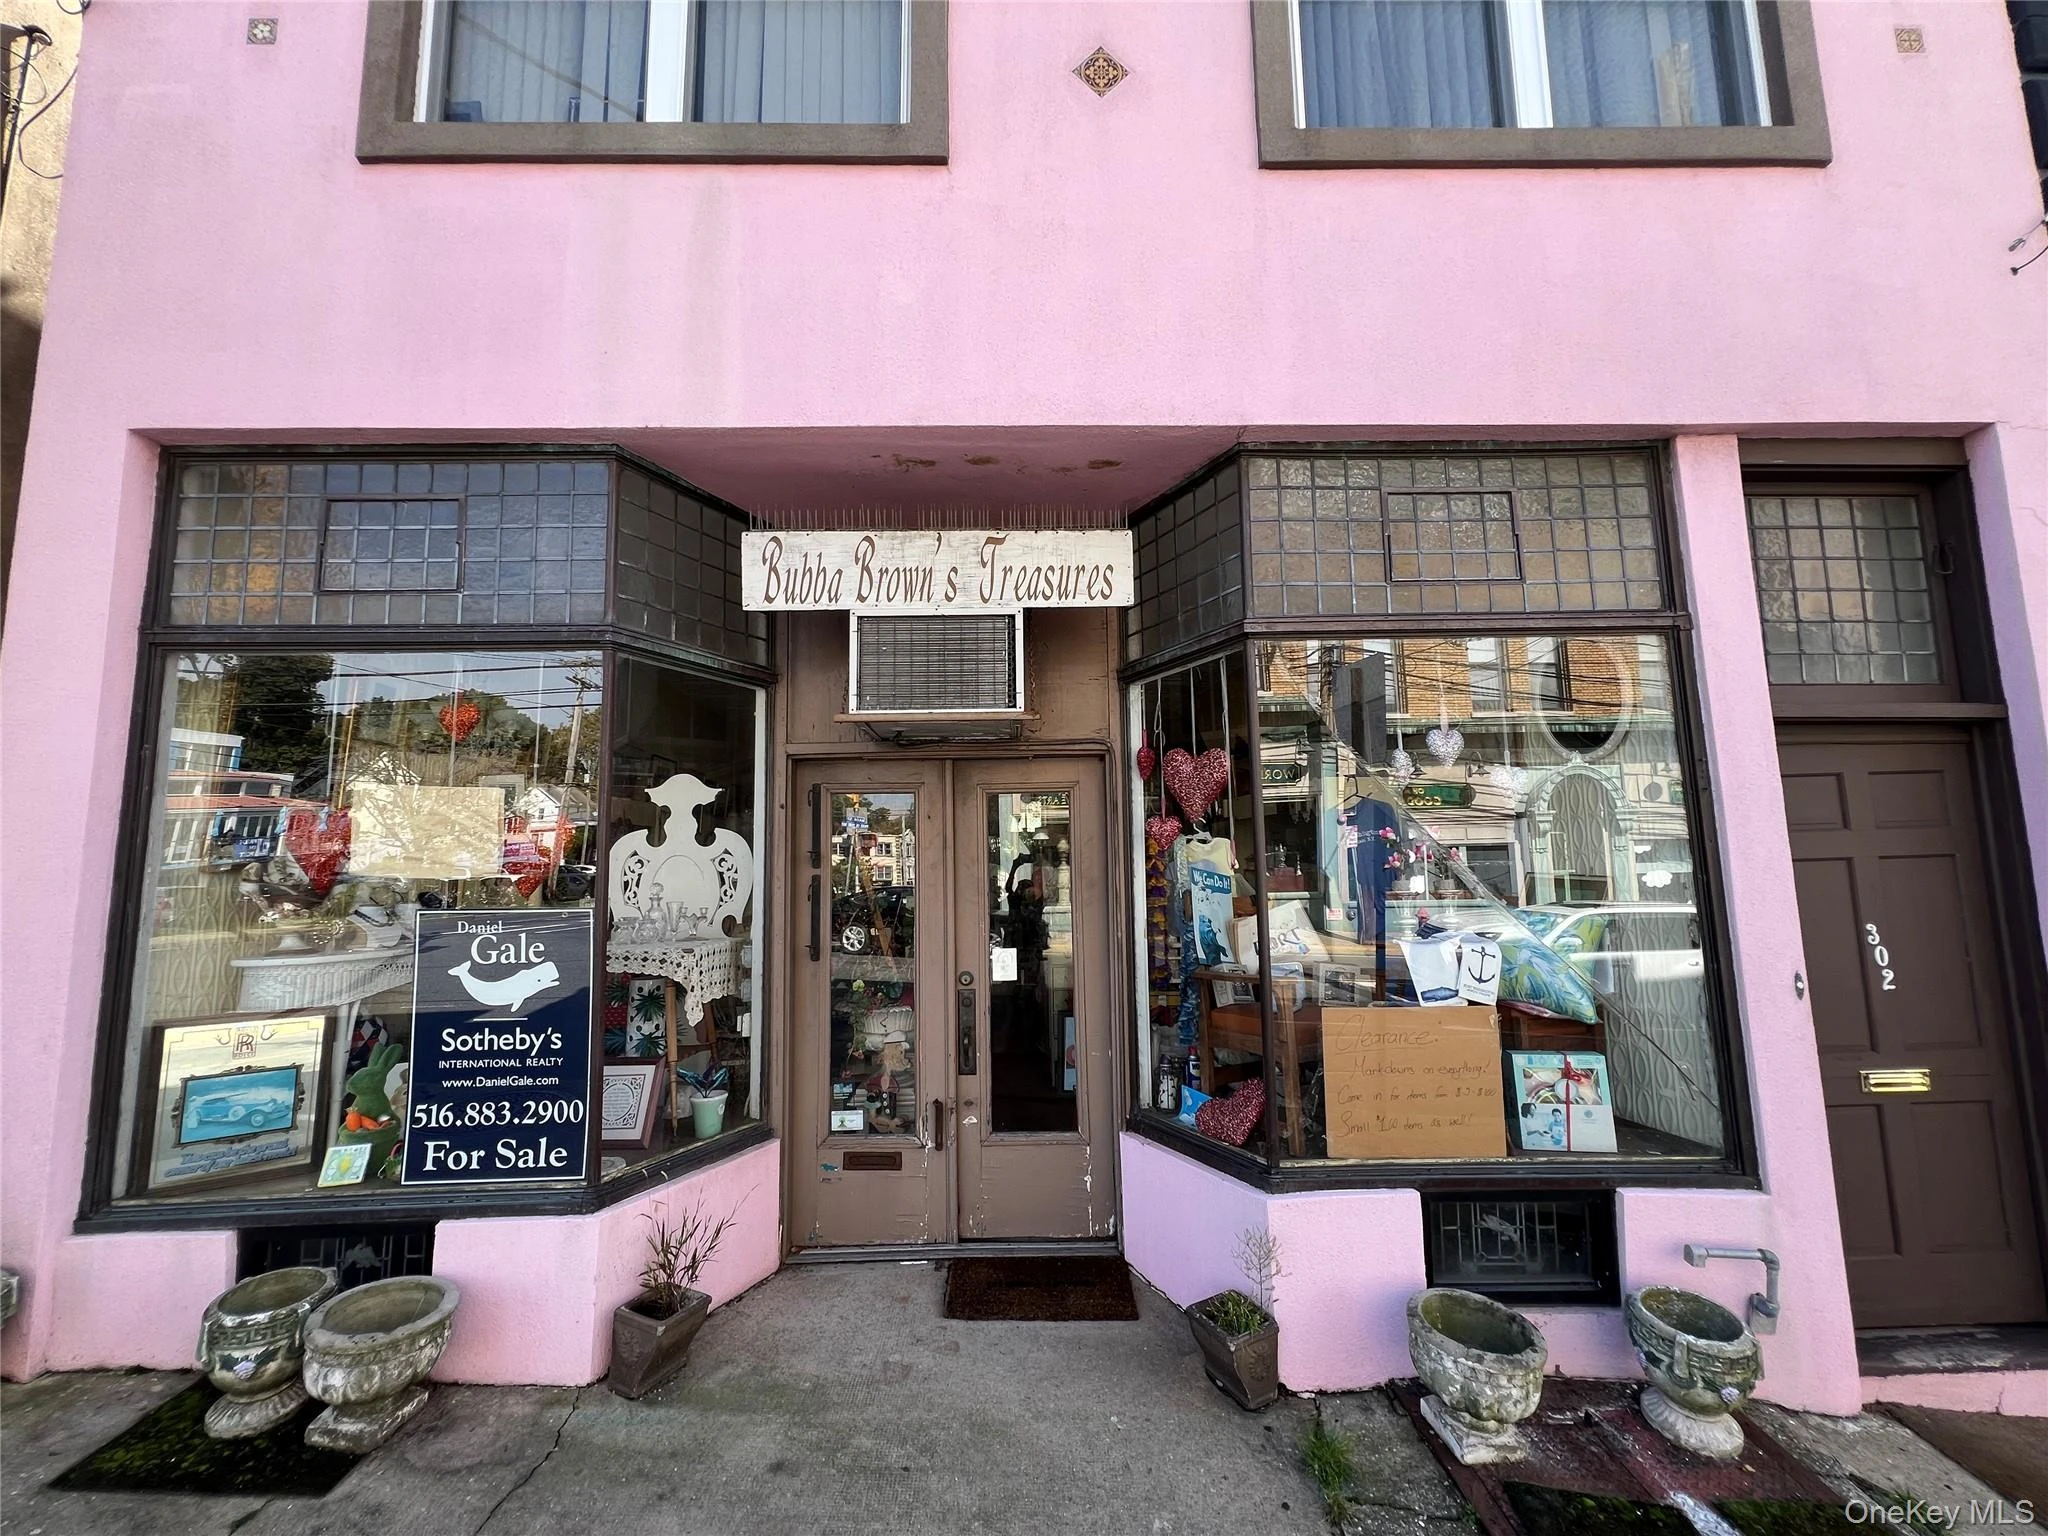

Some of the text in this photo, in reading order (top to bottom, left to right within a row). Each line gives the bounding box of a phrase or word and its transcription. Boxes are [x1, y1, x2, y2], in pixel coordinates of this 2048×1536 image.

[762, 532, 1114, 604] Bubba Brown's Treasures
[1192, 869, 1202, 882] We
[1202, 873, 1215, 886] Can
[1214, 875, 1223, 888] Do
[457, 920, 503, 934] Daniel
[470, 933, 545, 965] Gale
[1865, 923, 1896, 990] 302
[441, 1027, 562, 1057] Sotheby's
[438, 1057, 564, 1069] INTERNATIONAL REALTY
[442, 1075, 559, 1088] www.DanielGale.com
[1373, 1092, 1382, 1101] in
[412, 1099, 584, 1128] 516.883.2900
[1337, 1111, 1370, 1137] Small
[423, 1136, 568, 1171] For Sale
